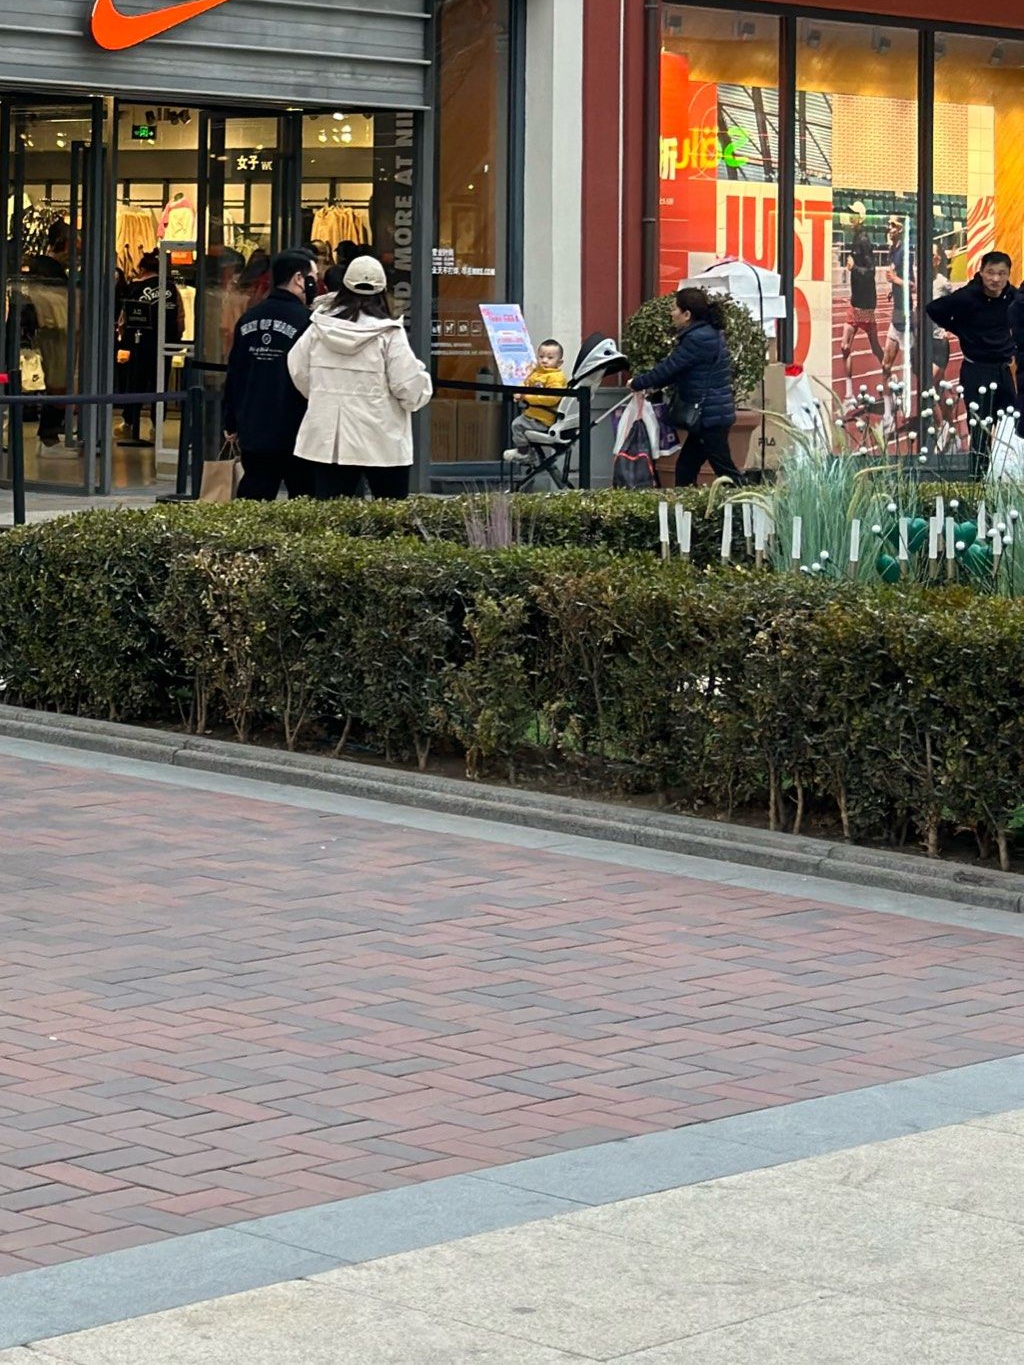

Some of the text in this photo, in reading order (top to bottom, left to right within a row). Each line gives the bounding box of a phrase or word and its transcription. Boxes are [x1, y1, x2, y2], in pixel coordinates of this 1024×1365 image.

[236, 155, 259, 171] 女子
[394, 155, 413, 185] AT
[394, 195, 413, 272] MORE
[758, 436, 776, 447] FLA
